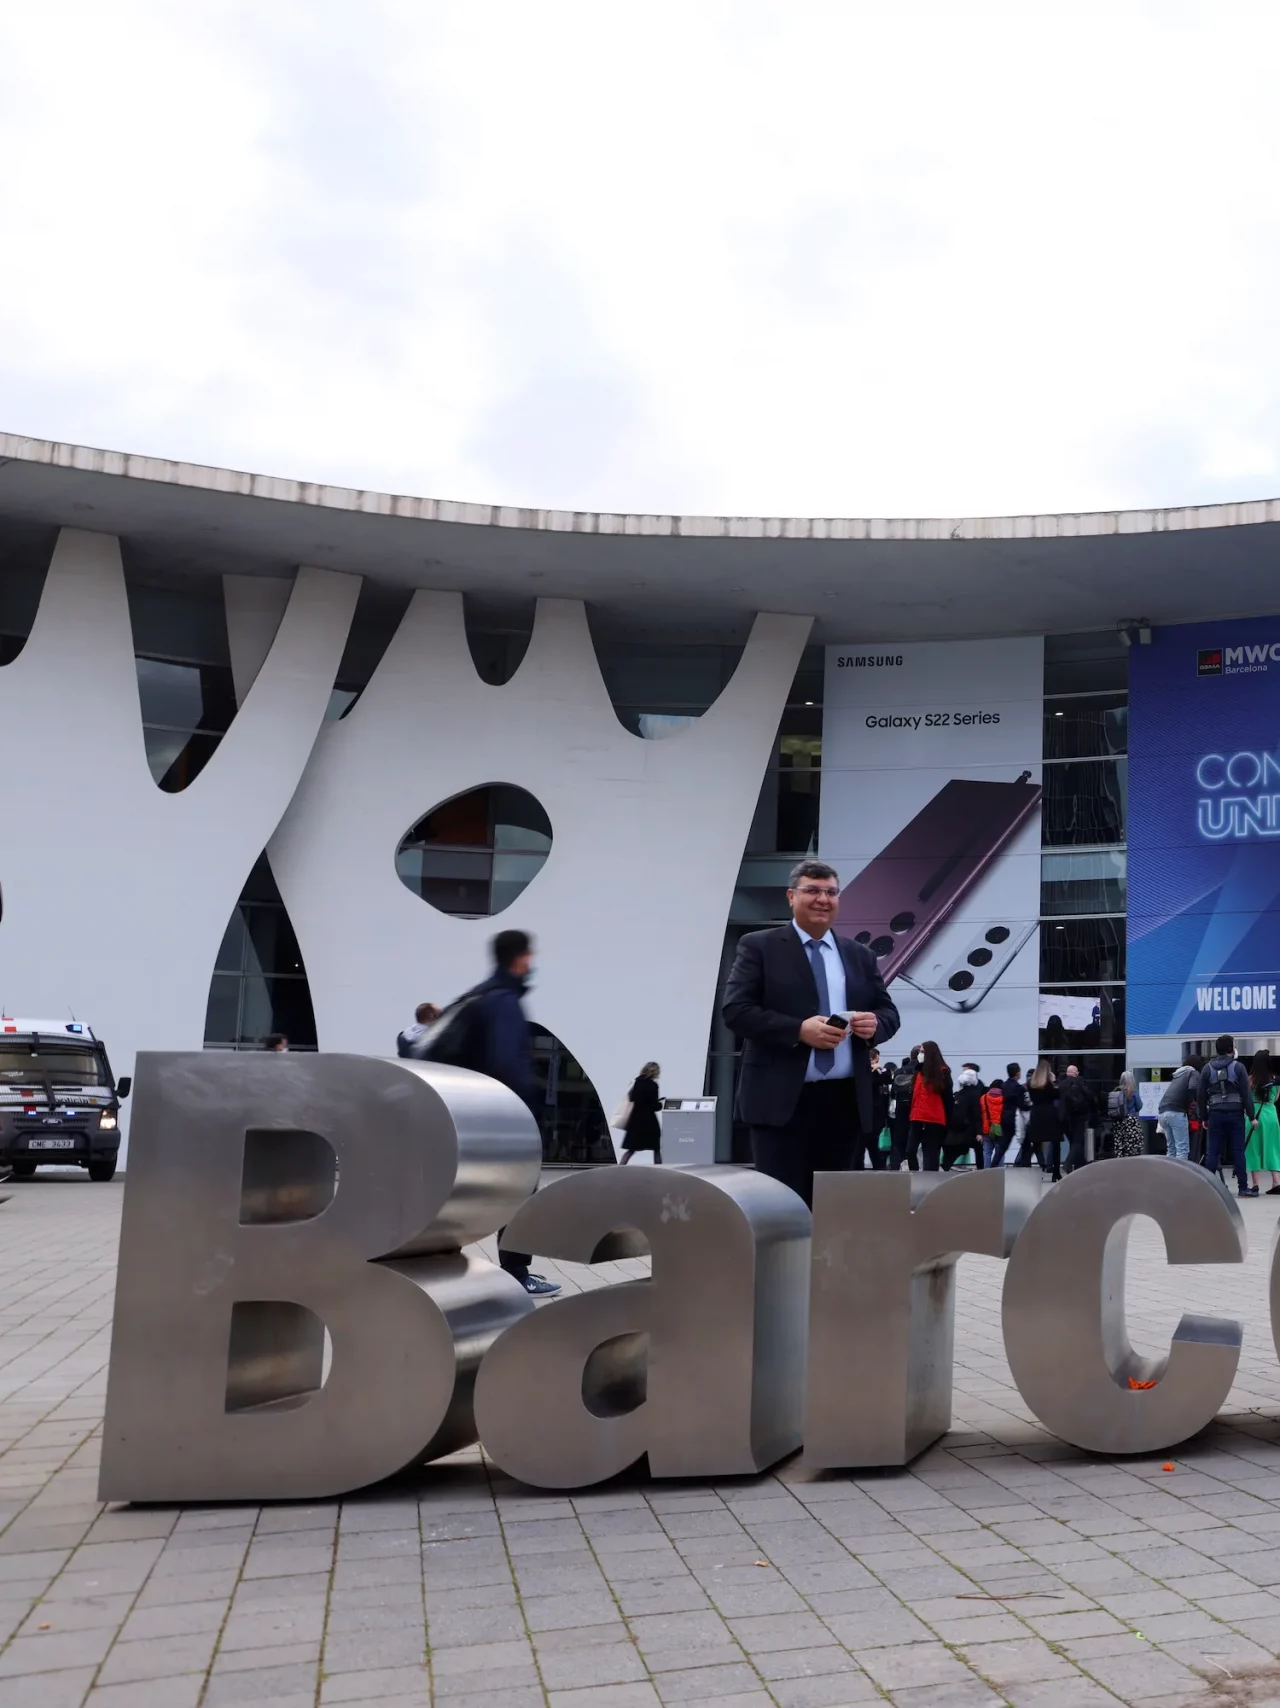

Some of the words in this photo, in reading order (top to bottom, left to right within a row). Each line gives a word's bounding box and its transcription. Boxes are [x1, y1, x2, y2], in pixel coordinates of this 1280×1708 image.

[837, 655, 904, 668] SAMSUNG
[1225, 664, 1268, 675] Barcelona
[865, 714, 922, 730] Galaxy
[924, 713, 950, 727] S22
[953, 710, 1001, 726] Series
[1196, 985, 1277, 1011] WELCOME
[31, 1140, 45, 1149] CME
